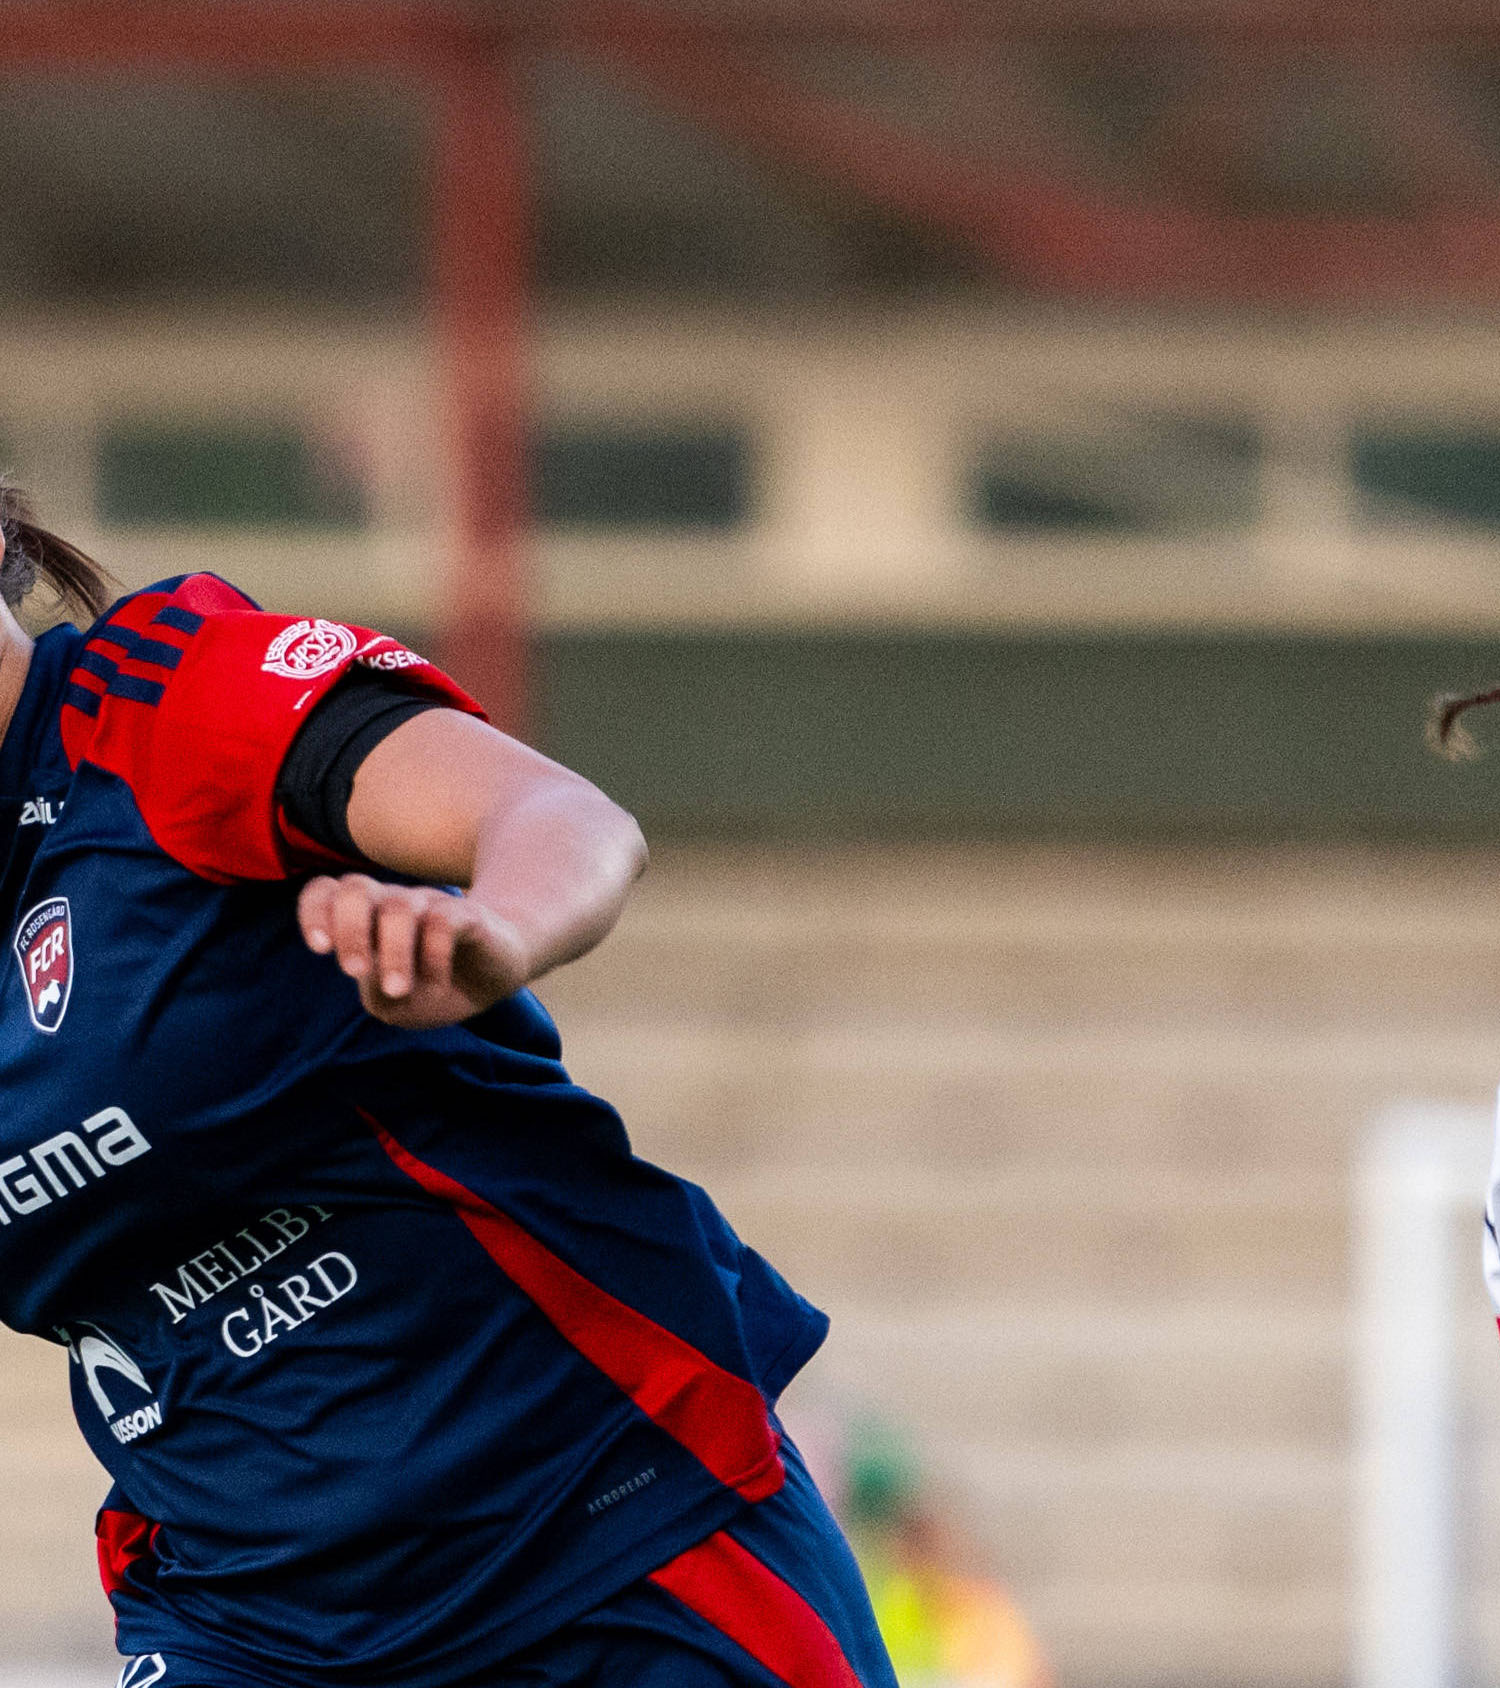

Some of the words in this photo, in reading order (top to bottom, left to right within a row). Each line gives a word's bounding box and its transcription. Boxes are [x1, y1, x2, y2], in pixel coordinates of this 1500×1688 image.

[30, 926, 65, 985] FCR
[222, 1250, 359, 1358] GÅRD
[586, 1467, 657, 1515] AEROREADY
